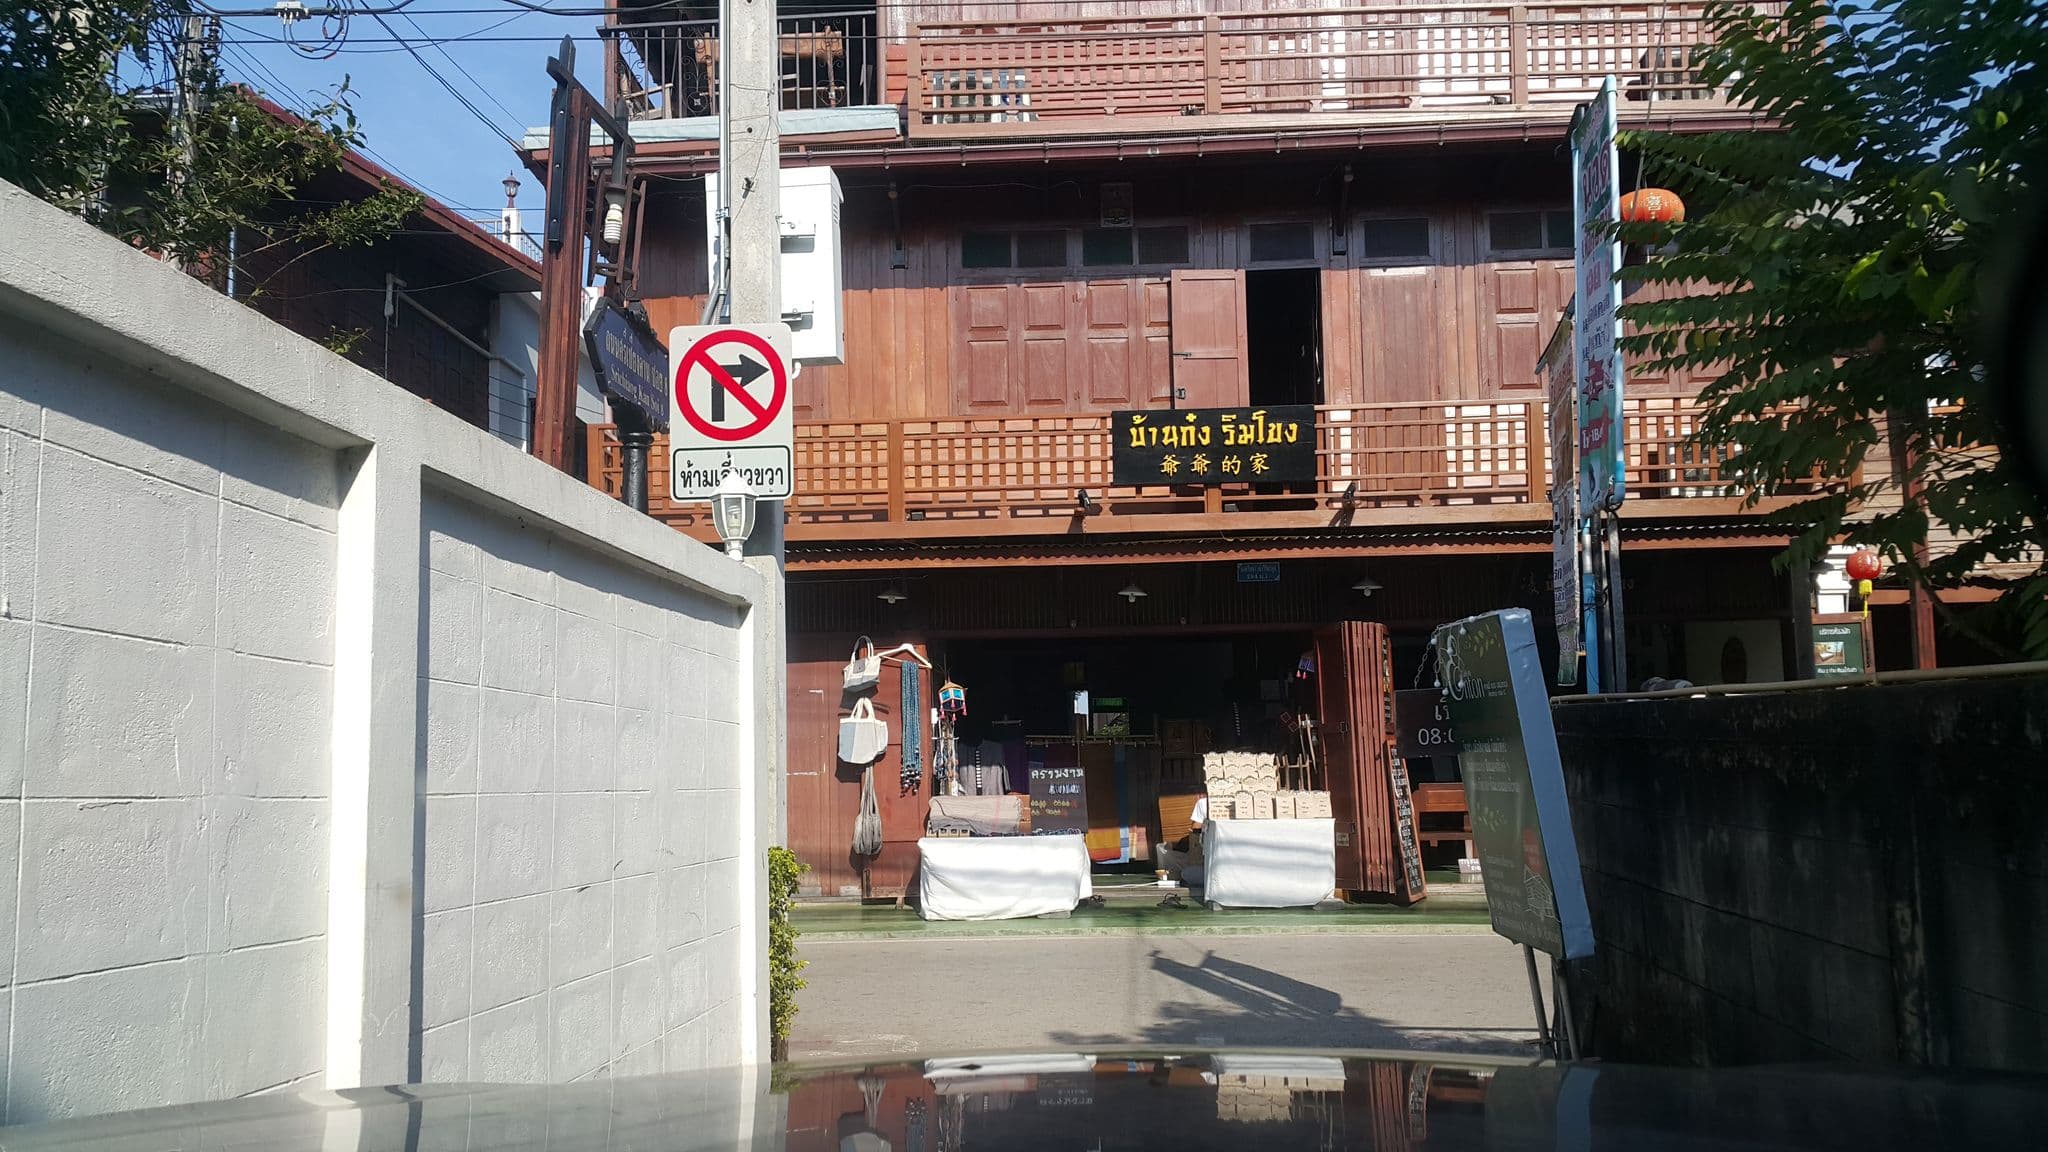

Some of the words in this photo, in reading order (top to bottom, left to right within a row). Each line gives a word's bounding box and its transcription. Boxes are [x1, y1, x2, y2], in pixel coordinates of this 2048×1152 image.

[1129, 412, 1211, 449] บ้านก๋ง
[1220, 409, 1299, 446] ริมโขง
[680, 451, 784, 488] ห้ามเลี้วขวา
